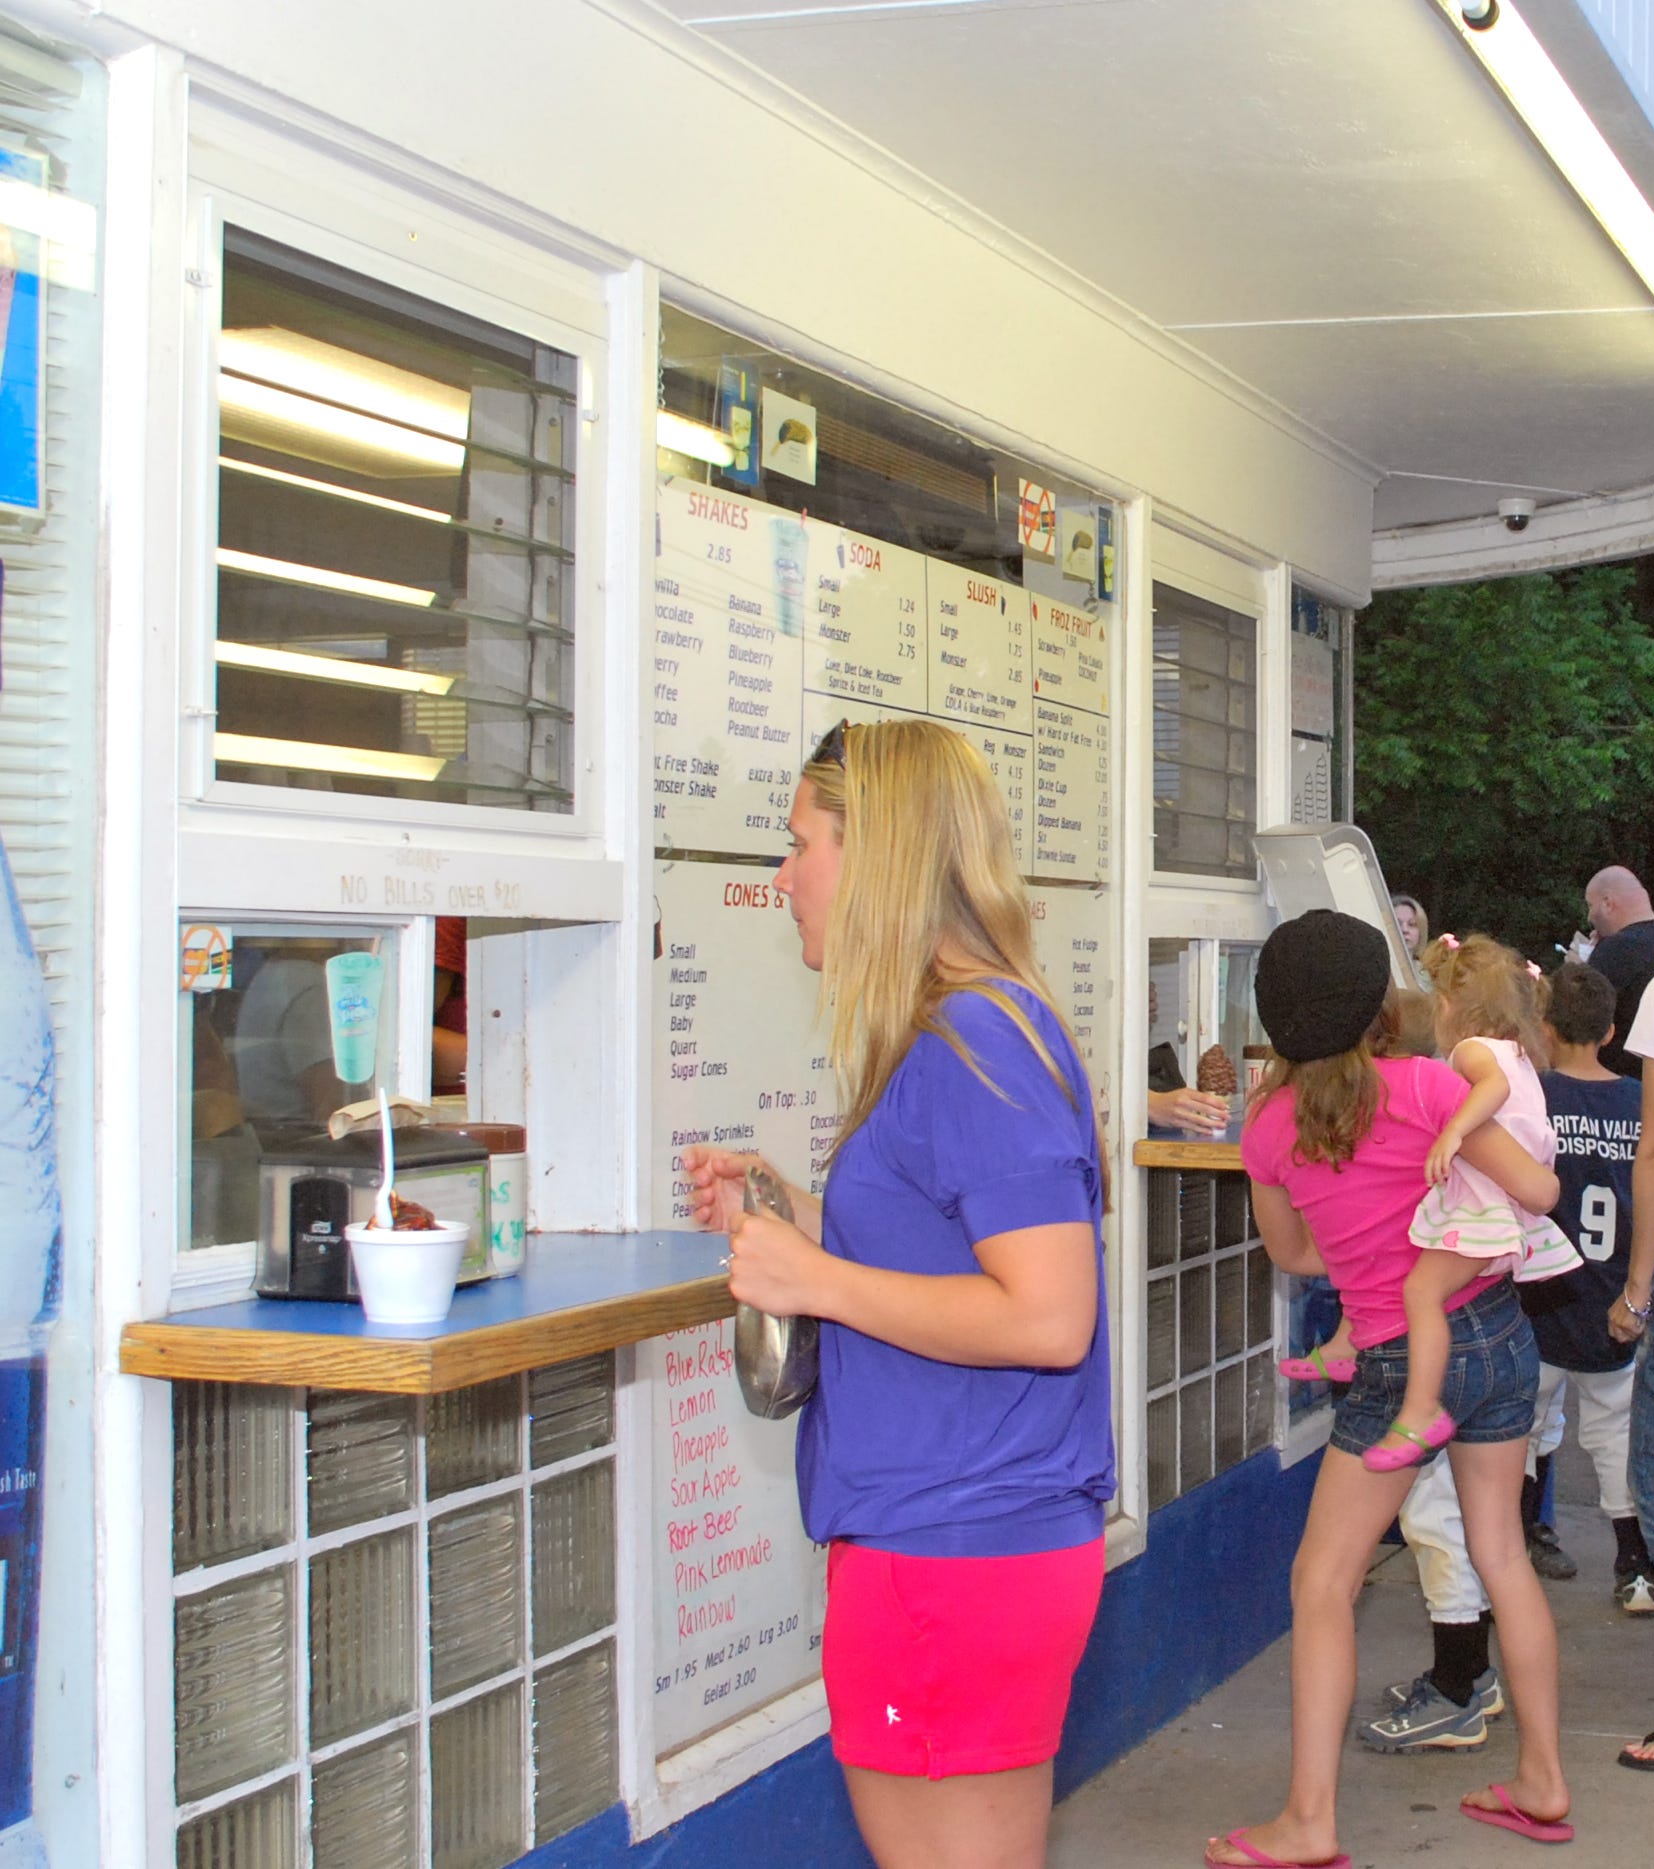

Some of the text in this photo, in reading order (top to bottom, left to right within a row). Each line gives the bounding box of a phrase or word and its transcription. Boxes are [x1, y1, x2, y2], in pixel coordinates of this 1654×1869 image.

[687, 491, 749, 531] SHAKES
[707, 543, 732, 563] 2.85
[849, 542, 882, 571] SODA
[819, 574, 841, 593] Small
[966, 580, 997, 608] SLUSH
[729, 594, 762, 616] Banana
[818, 598, 841, 618] Large
[898, 597, 915, 614] 1.24
[728, 617, 776, 644] Raspberry
[818, 622, 852, 643] Monster
[898, 621, 916, 639] 1.50
[940, 622, 959, 641] Large
[1050, 607, 1092, 639] FROZ FRUIT
[728, 644, 774, 670] Blueberry
[897, 642, 917, 660] 2.75
[728, 670, 773, 693] Pineapple
[728, 696, 769, 718] Rootbeer
[728, 719, 791, 744] Peanut Butter
[664, 754, 688, 774] Free
[690, 757, 720, 777] Shake
[748, 767, 773, 783] extra
[688, 779, 718, 798] Shake
[768, 791, 789, 809] 4.65
[746, 814, 770, 829] extra
[340, 875, 522, 911] NO BILLS OVER $20
[724, 882, 769, 909] CONES
[669, 943, 696, 960] Small
[669, 967, 708, 984] Medium
[669, 992, 697, 1010] Large
[670, 1015, 694, 1034] Baby
[670, 1039, 697, 1057] Quart
[670, 1060, 728, 1082] Sugar Cones
[758, 1092, 772, 1110] On
[800, 1090, 817, 1107] .30
[671, 1122, 755, 1148] Rainbow Sprinkles
[1556, 1137, 1636, 1161] DISPOSAL
[1579, 1184, 1617, 1262] 9
[666, 1351, 696, 1388] Blue
[669, 1387, 717, 1428] Lemon
[672, 1423, 729, 1475] Pineapple
[670, 1464, 741, 1508] Sour Apple
[667, 1504, 743, 1554] Root Beer
[674, 1533, 773, 1599] Pink Lemonade
[677, 1594, 737, 1646] Rainbow
[655, 1614, 800, 1694] Sm 1.95 Med 2.60 Lrg 3.00
[703, 1666, 758, 1706] Gelati 3.00
